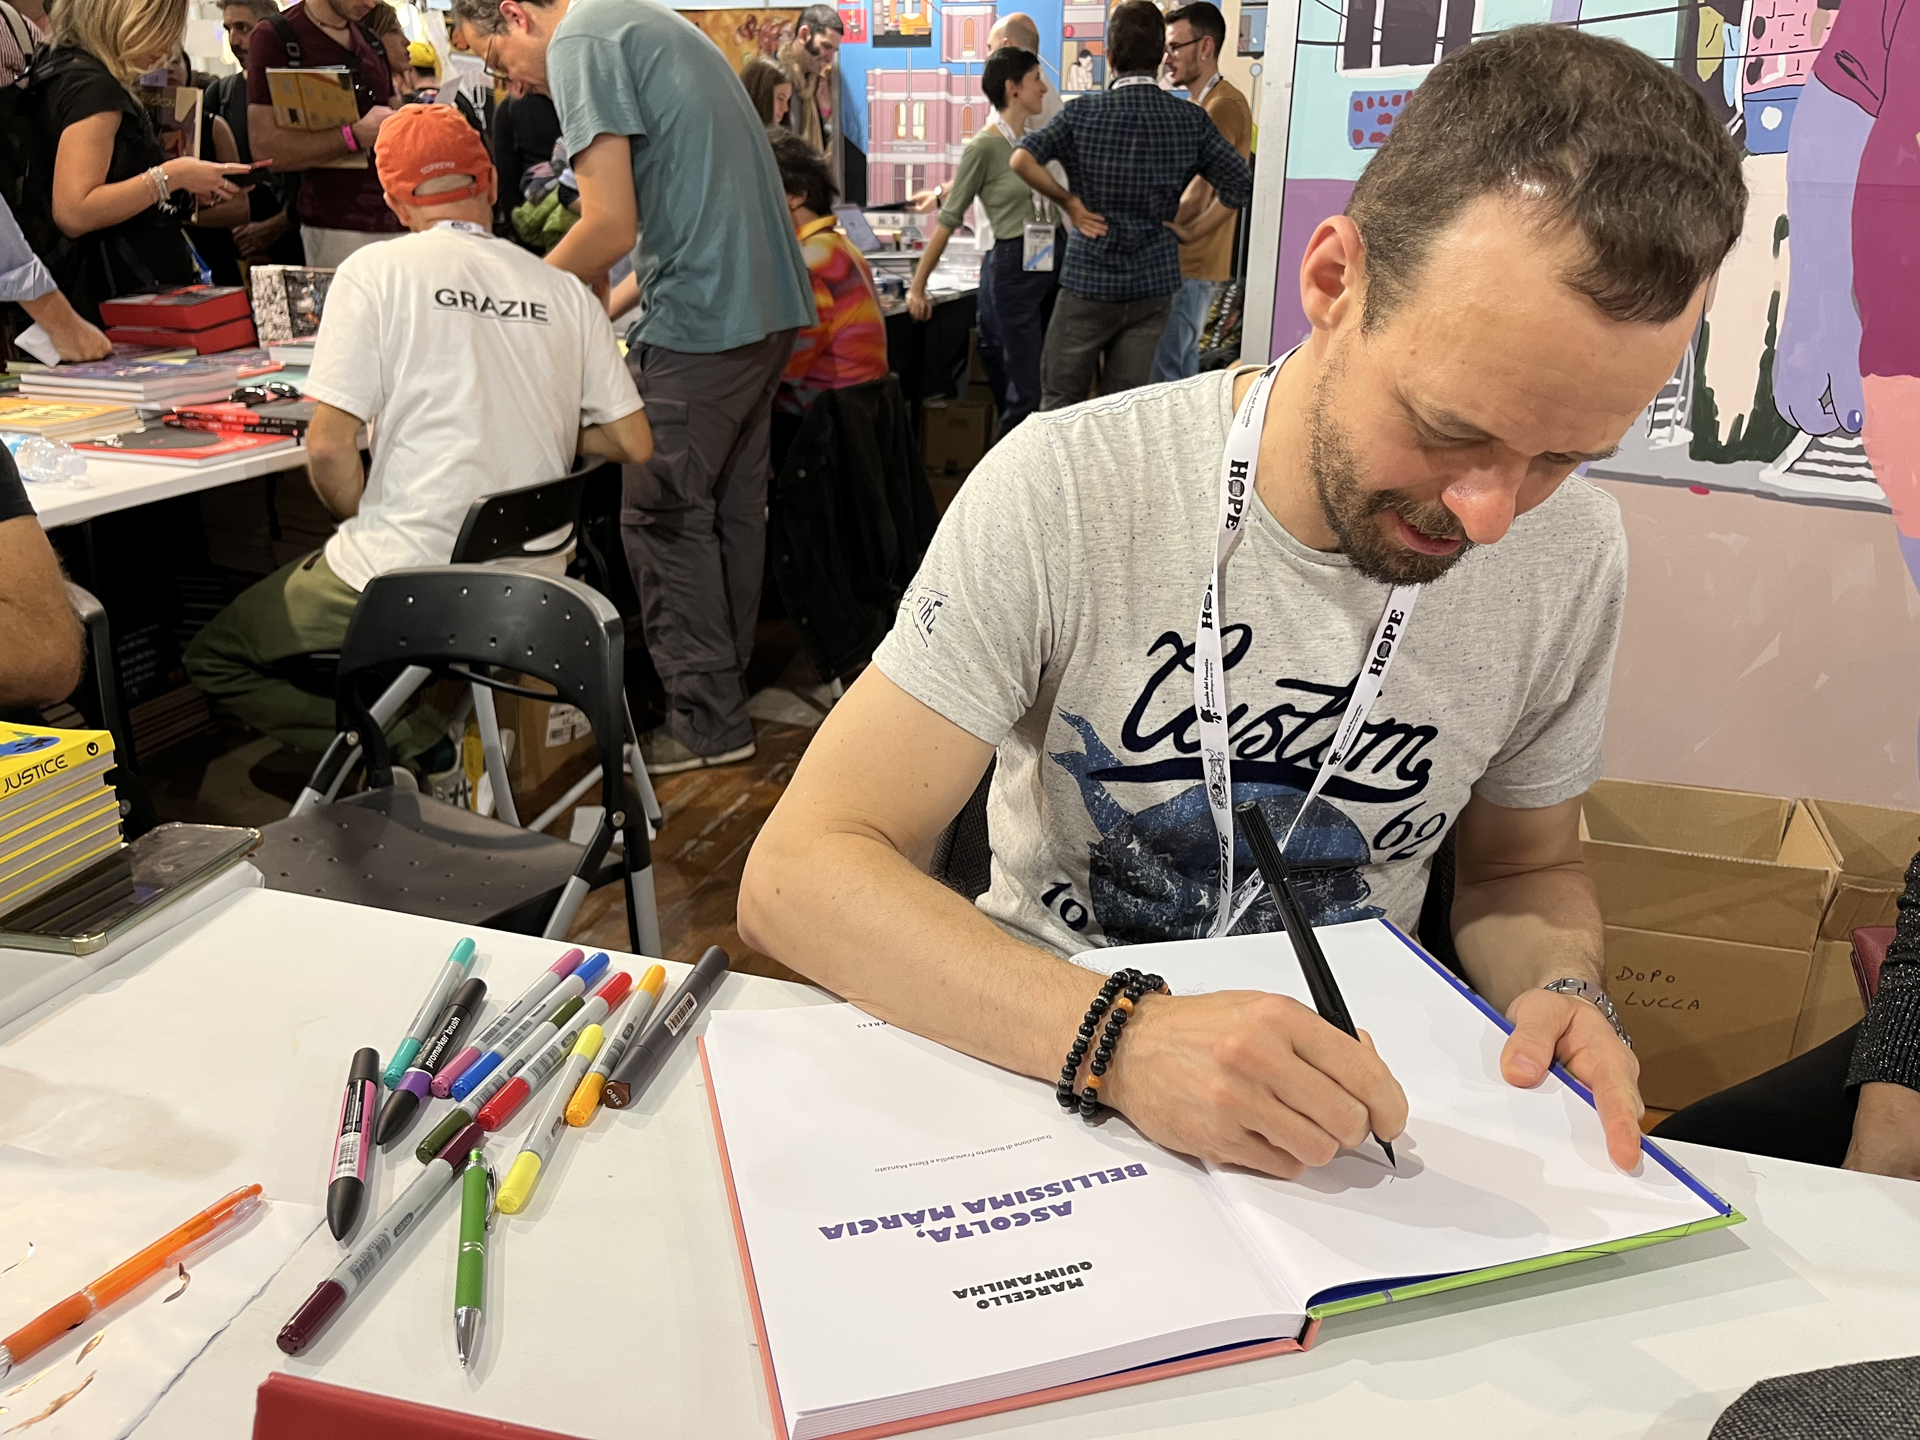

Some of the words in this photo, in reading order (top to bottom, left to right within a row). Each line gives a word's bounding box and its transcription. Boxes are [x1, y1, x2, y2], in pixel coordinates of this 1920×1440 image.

[435, 288, 549, 322] GRAZIE
[1225, 459, 1249, 531] HOPE
[1368, 609, 1405, 678] HOPE
[4, 754, 69, 793] JUSTICE
[1615, 966, 1676, 983] DOPO
[1624, 991, 1699, 1010] LUCCA
[425, 1034, 450, 1069] promarker
[443, 1015, 463, 1036] brush
[606, 1088, 623, 1107] 3190
[936, 1152, 976, 1163] Francavilla
[976, 1146, 1006, 1156] Roberto
[1014, 1134, 1053, 1148] Traduzione
[874, 1164, 908, 1173] Manzato
[961, 1162, 1149, 1214] BELLISSIMA
[818, 1205, 956, 1240] MÁRCIA
[916, 1200, 1073, 1243] ASCOLTA,
[952, 1261, 1093, 1299] QUINTANILHA
[976, 1277, 1085, 1310] MARCELLO
